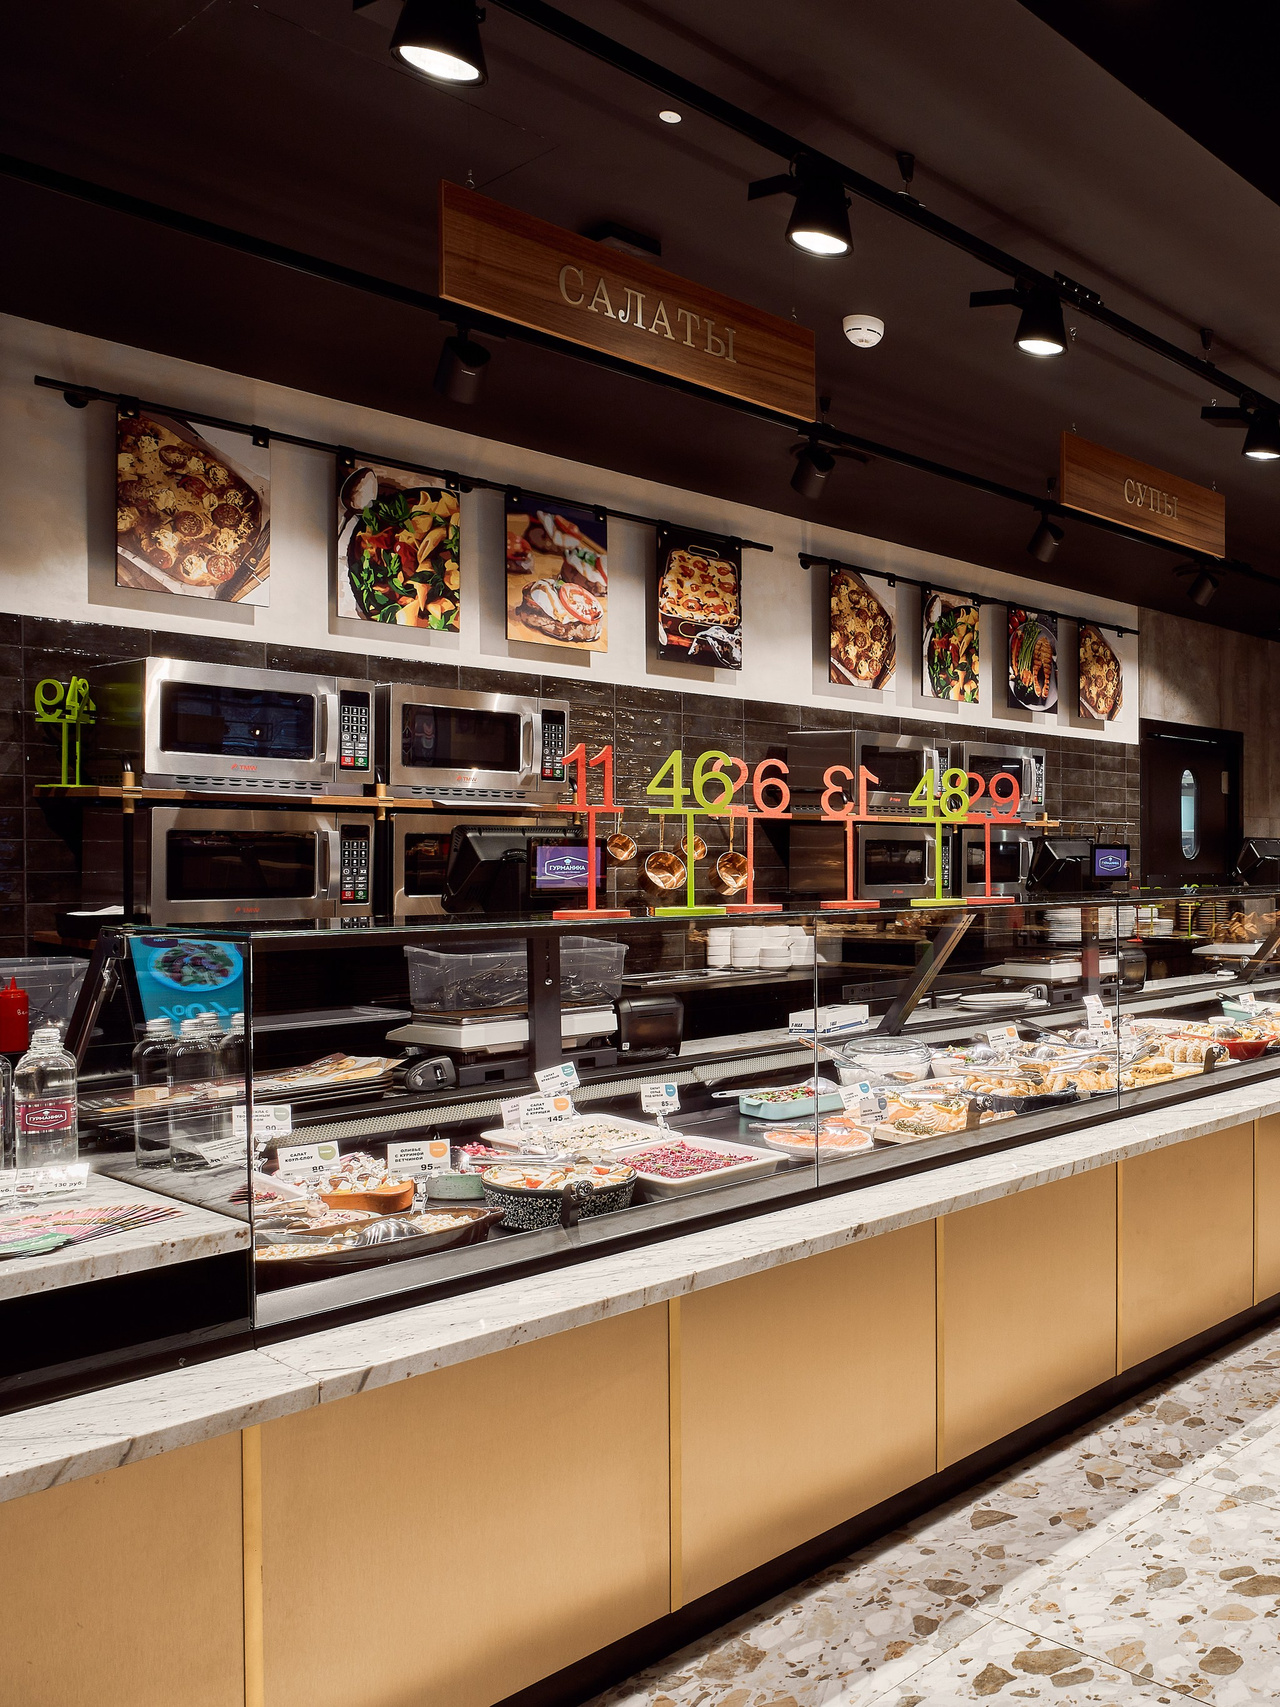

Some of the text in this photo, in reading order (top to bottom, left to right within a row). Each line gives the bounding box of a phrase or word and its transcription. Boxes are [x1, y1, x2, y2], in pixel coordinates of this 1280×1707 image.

[558, 264, 737, 364] САЛАТЫ
[1124, 478, 1179, 521] СУПЫ
[562, 743, 613, 806] 11
[646, 750, 734, 808] 46
[712, 757, 790, 813] 26
[908, 768, 970, 817] 48
[955, 772, 1021, 816] 29
[548, 1115, 563, 1123] 145
